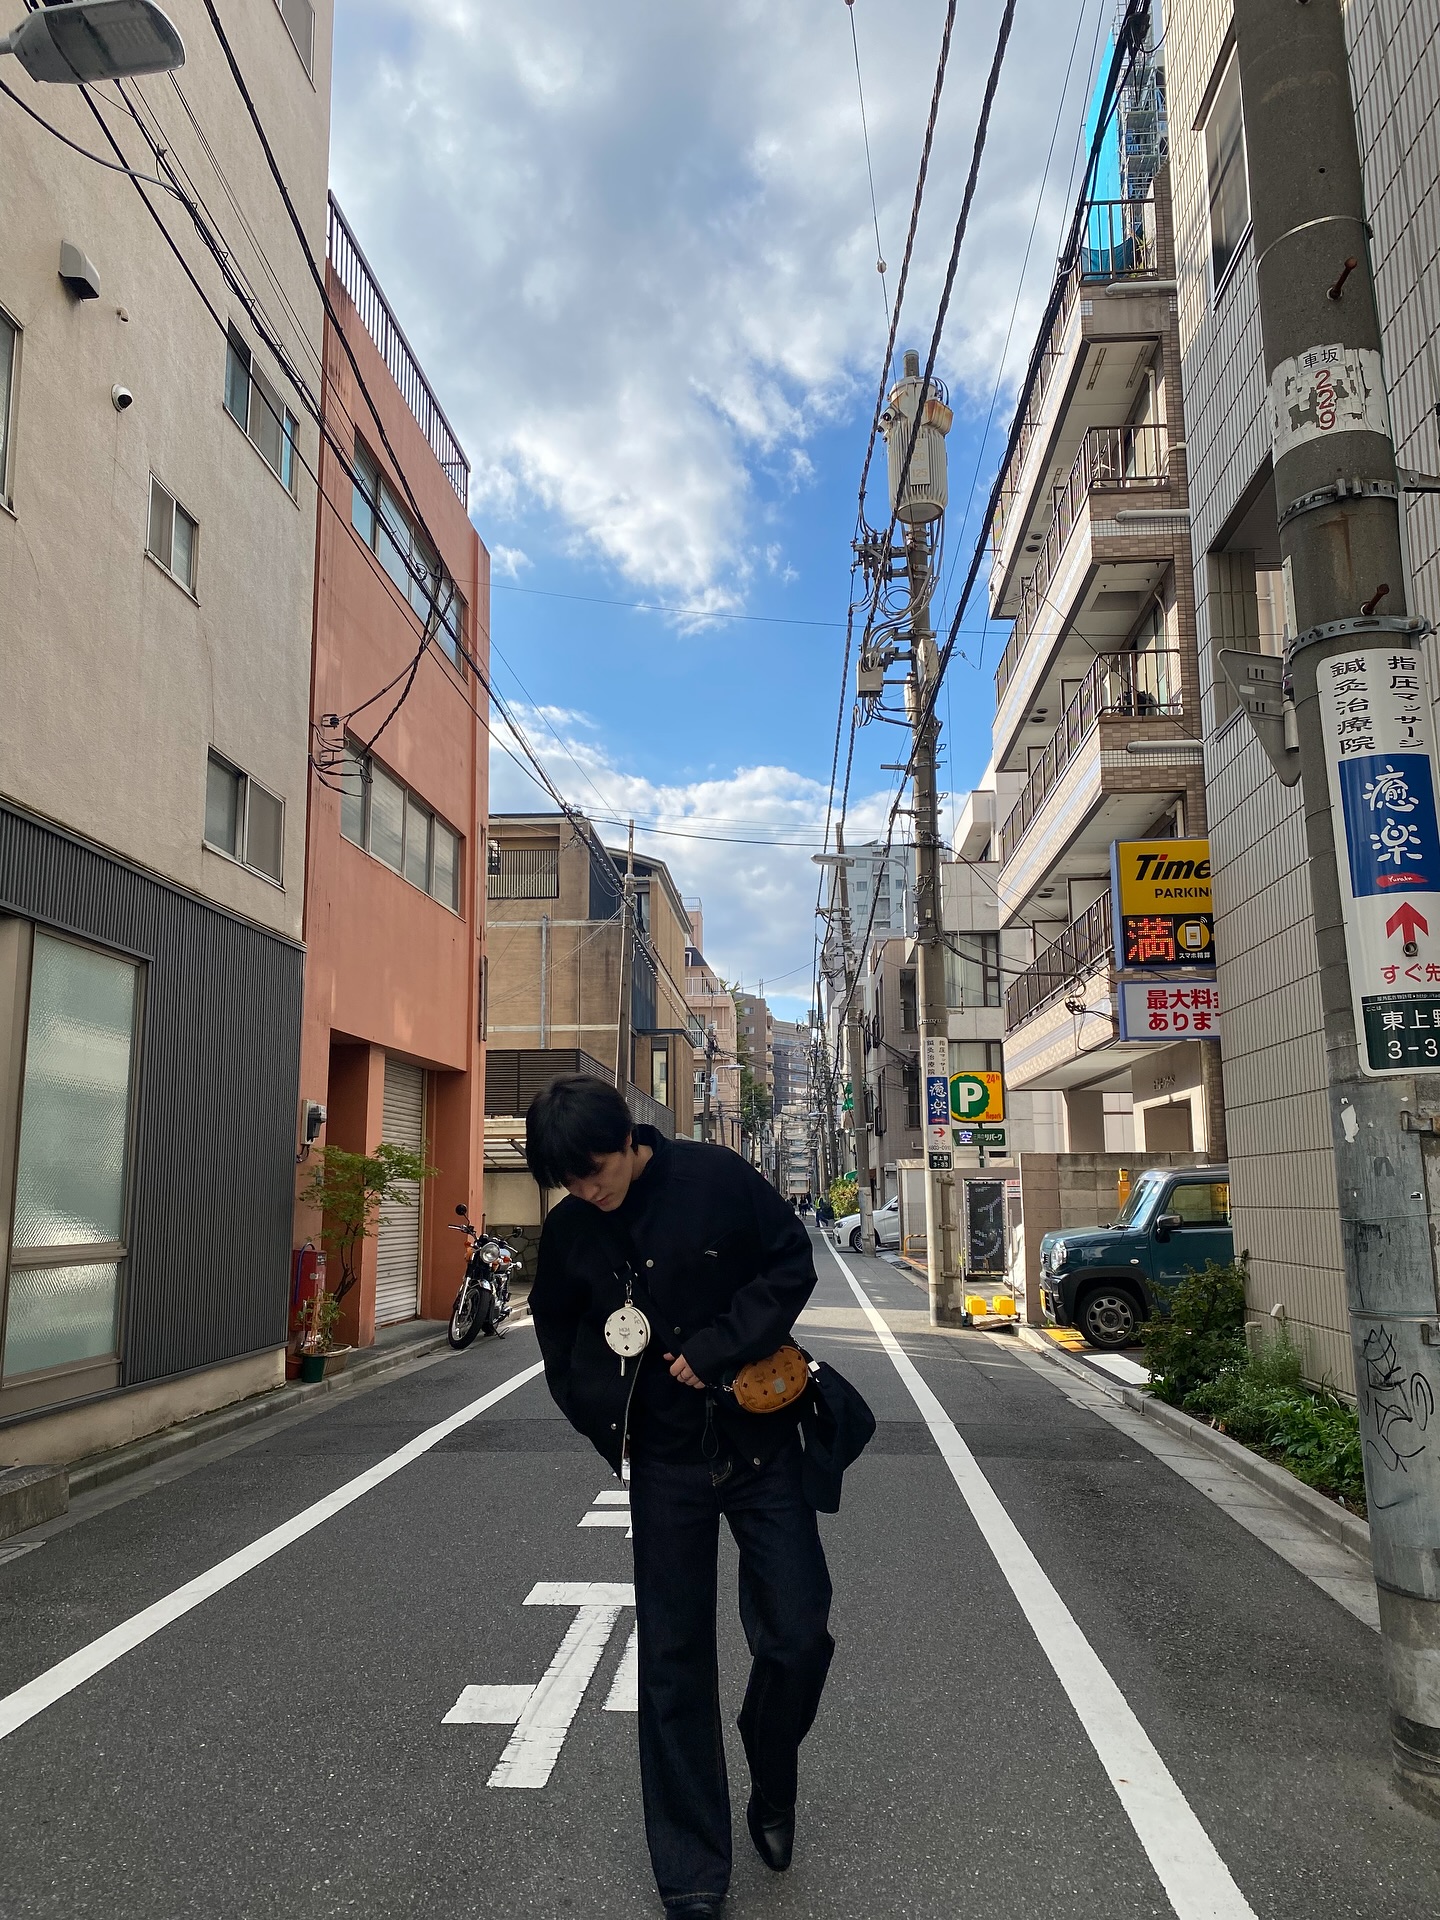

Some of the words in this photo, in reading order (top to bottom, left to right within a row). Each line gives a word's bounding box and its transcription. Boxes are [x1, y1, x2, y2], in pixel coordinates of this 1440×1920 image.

[1303, 348, 1338, 368] 車坂
[1315, 370, 1335, 430] 229
[1330, 657, 1375, 754] 鍼灸治療院
[1387, 656, 1424, 748] 指圧マッサージ
[1362, 764, 1423, 864] 癒楽
[1136, 854, 1210, 880] Time
[1155, 887, 1212, 898] PARKIN
[1128, 918, 1174, 961] 満
[959, 1082, 983, 1113] P
[959, 1131, 973, 1144] 空
